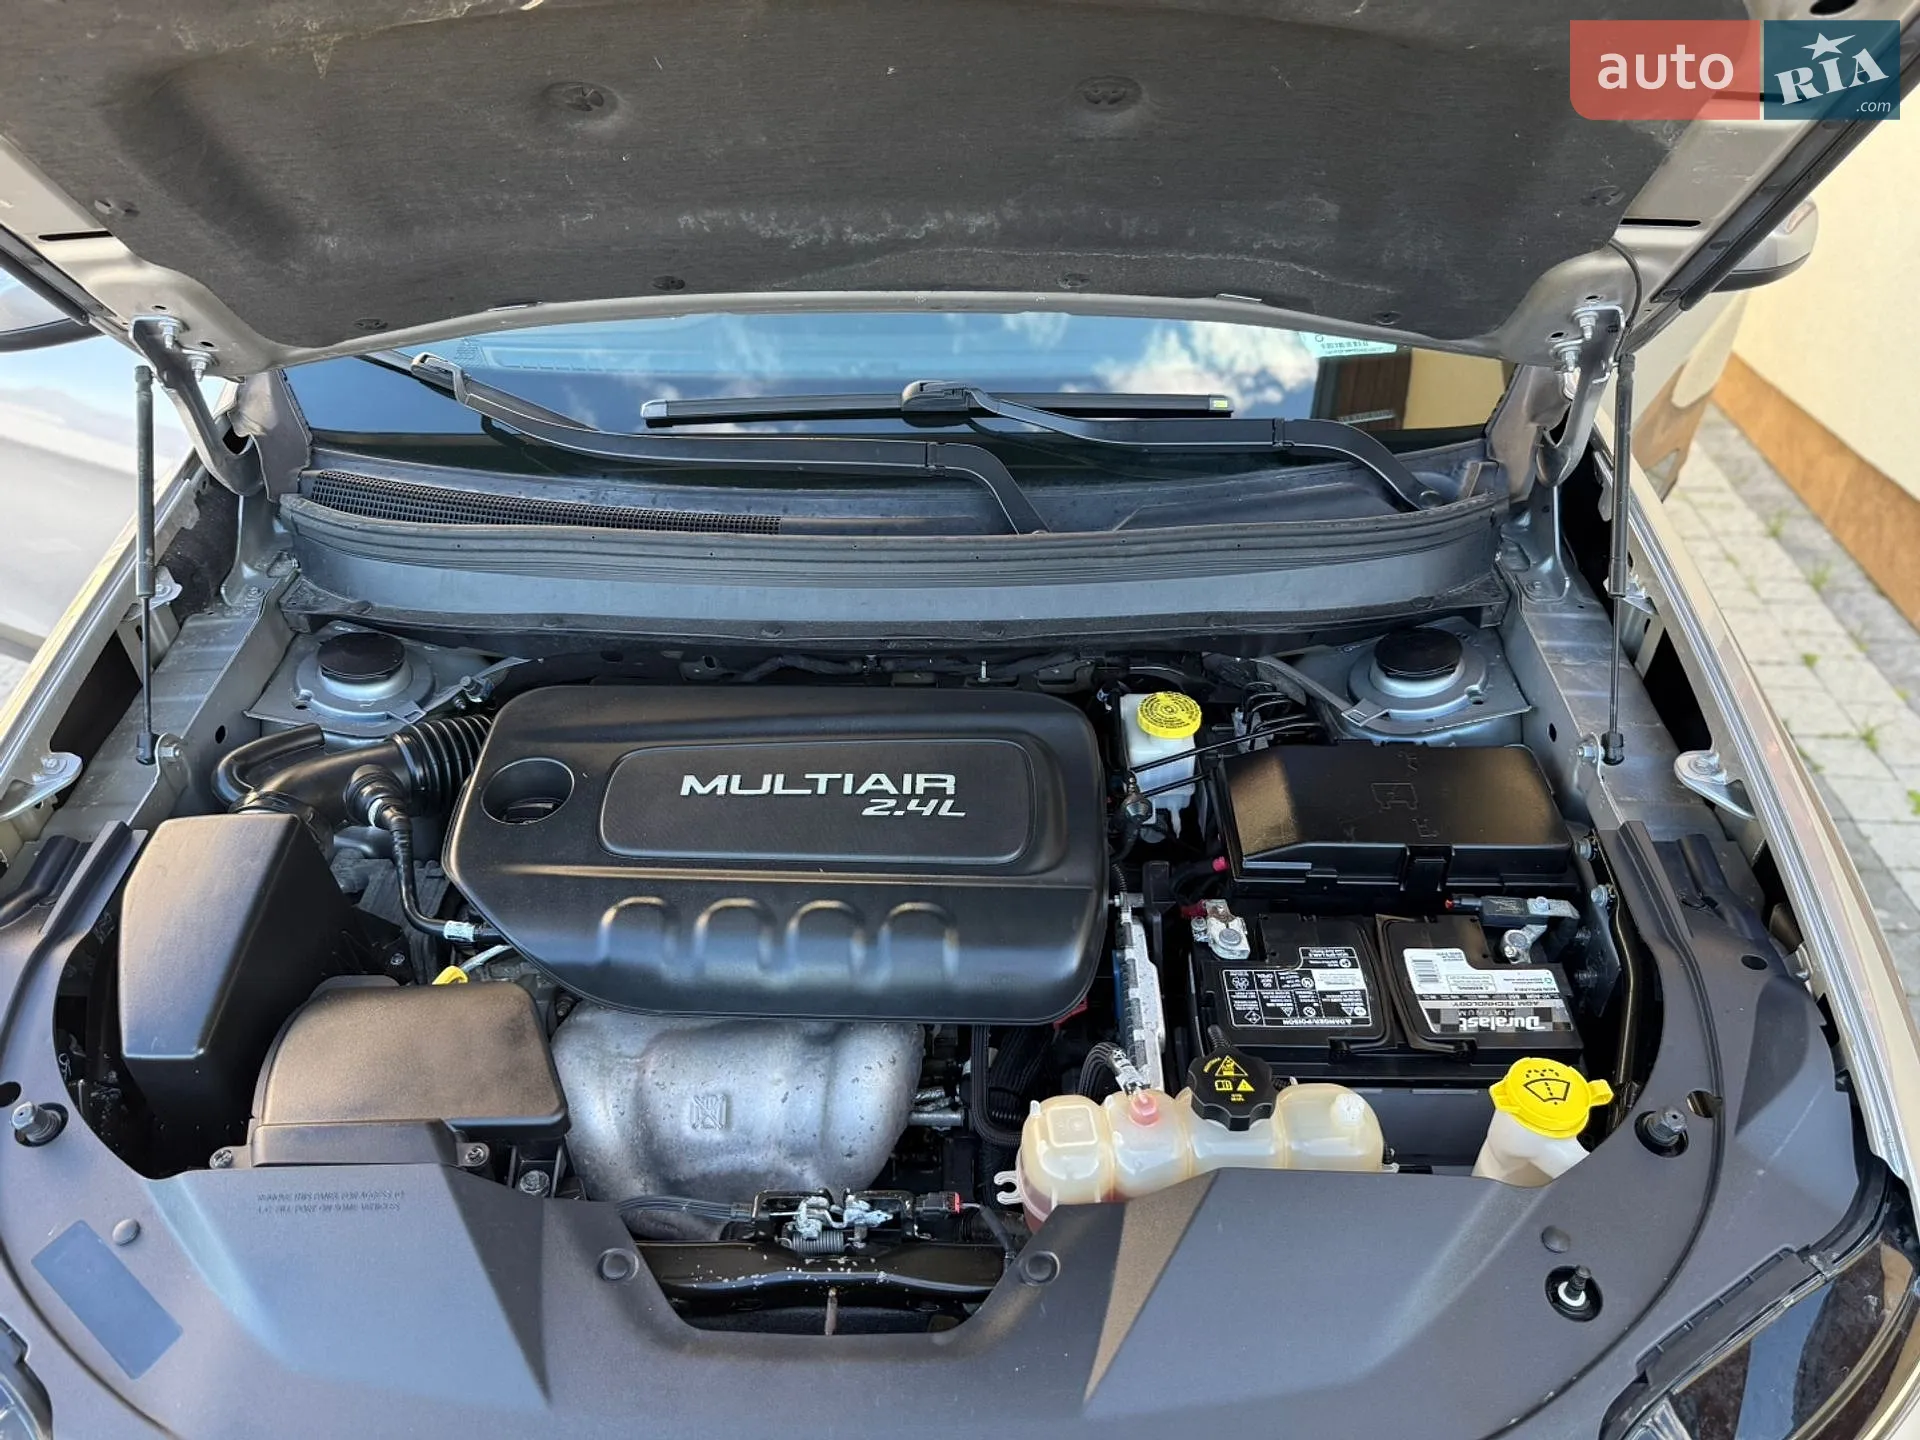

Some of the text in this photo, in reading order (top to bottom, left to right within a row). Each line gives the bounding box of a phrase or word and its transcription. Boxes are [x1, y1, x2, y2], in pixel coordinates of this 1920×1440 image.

[680, 773, 955, 796] MULTIAIR
[862, 799, 966, 817] 2.4L
[1458, 1008, 1515, 1016] PLATINUM
[1459, 1016, 1545, 1031] Duralast
